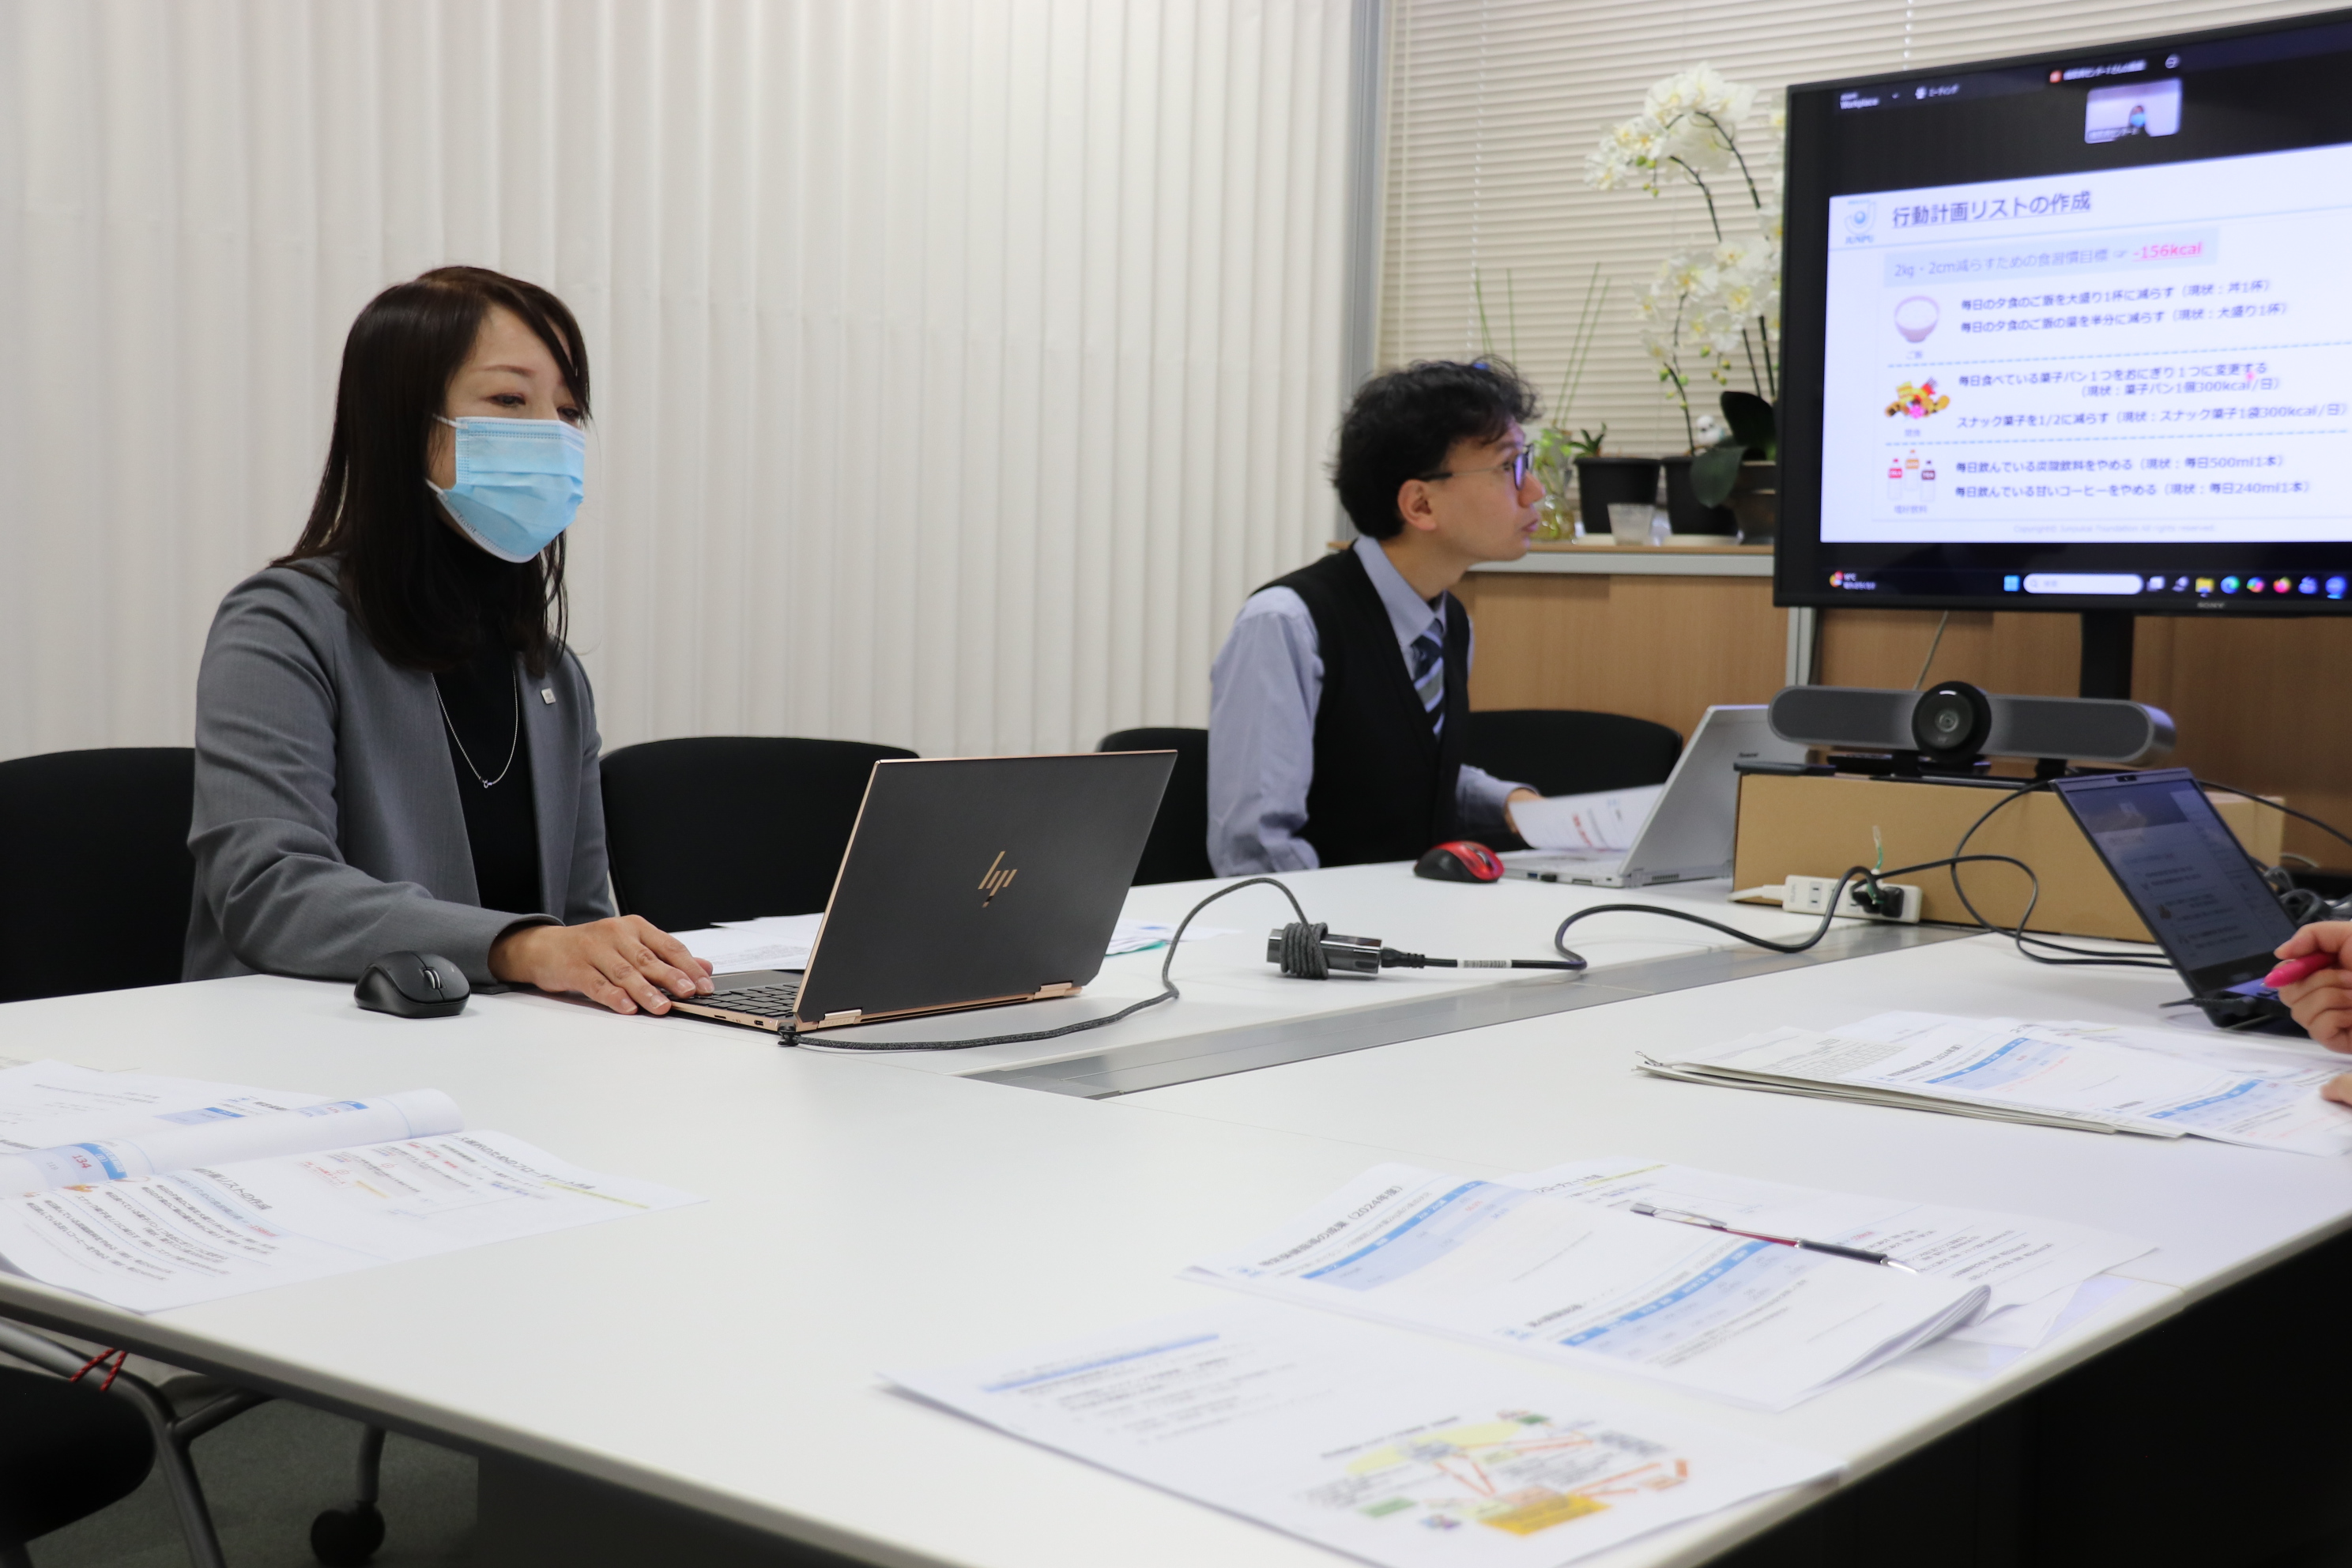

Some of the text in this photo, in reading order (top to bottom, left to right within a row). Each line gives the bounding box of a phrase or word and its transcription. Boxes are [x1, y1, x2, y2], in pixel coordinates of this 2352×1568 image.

[1892, 191, 2091, 228] 行動計画リストの作成
[2132, 241, 2203, 261] -156kcal
[72, 1154, 92, 1170] 134
